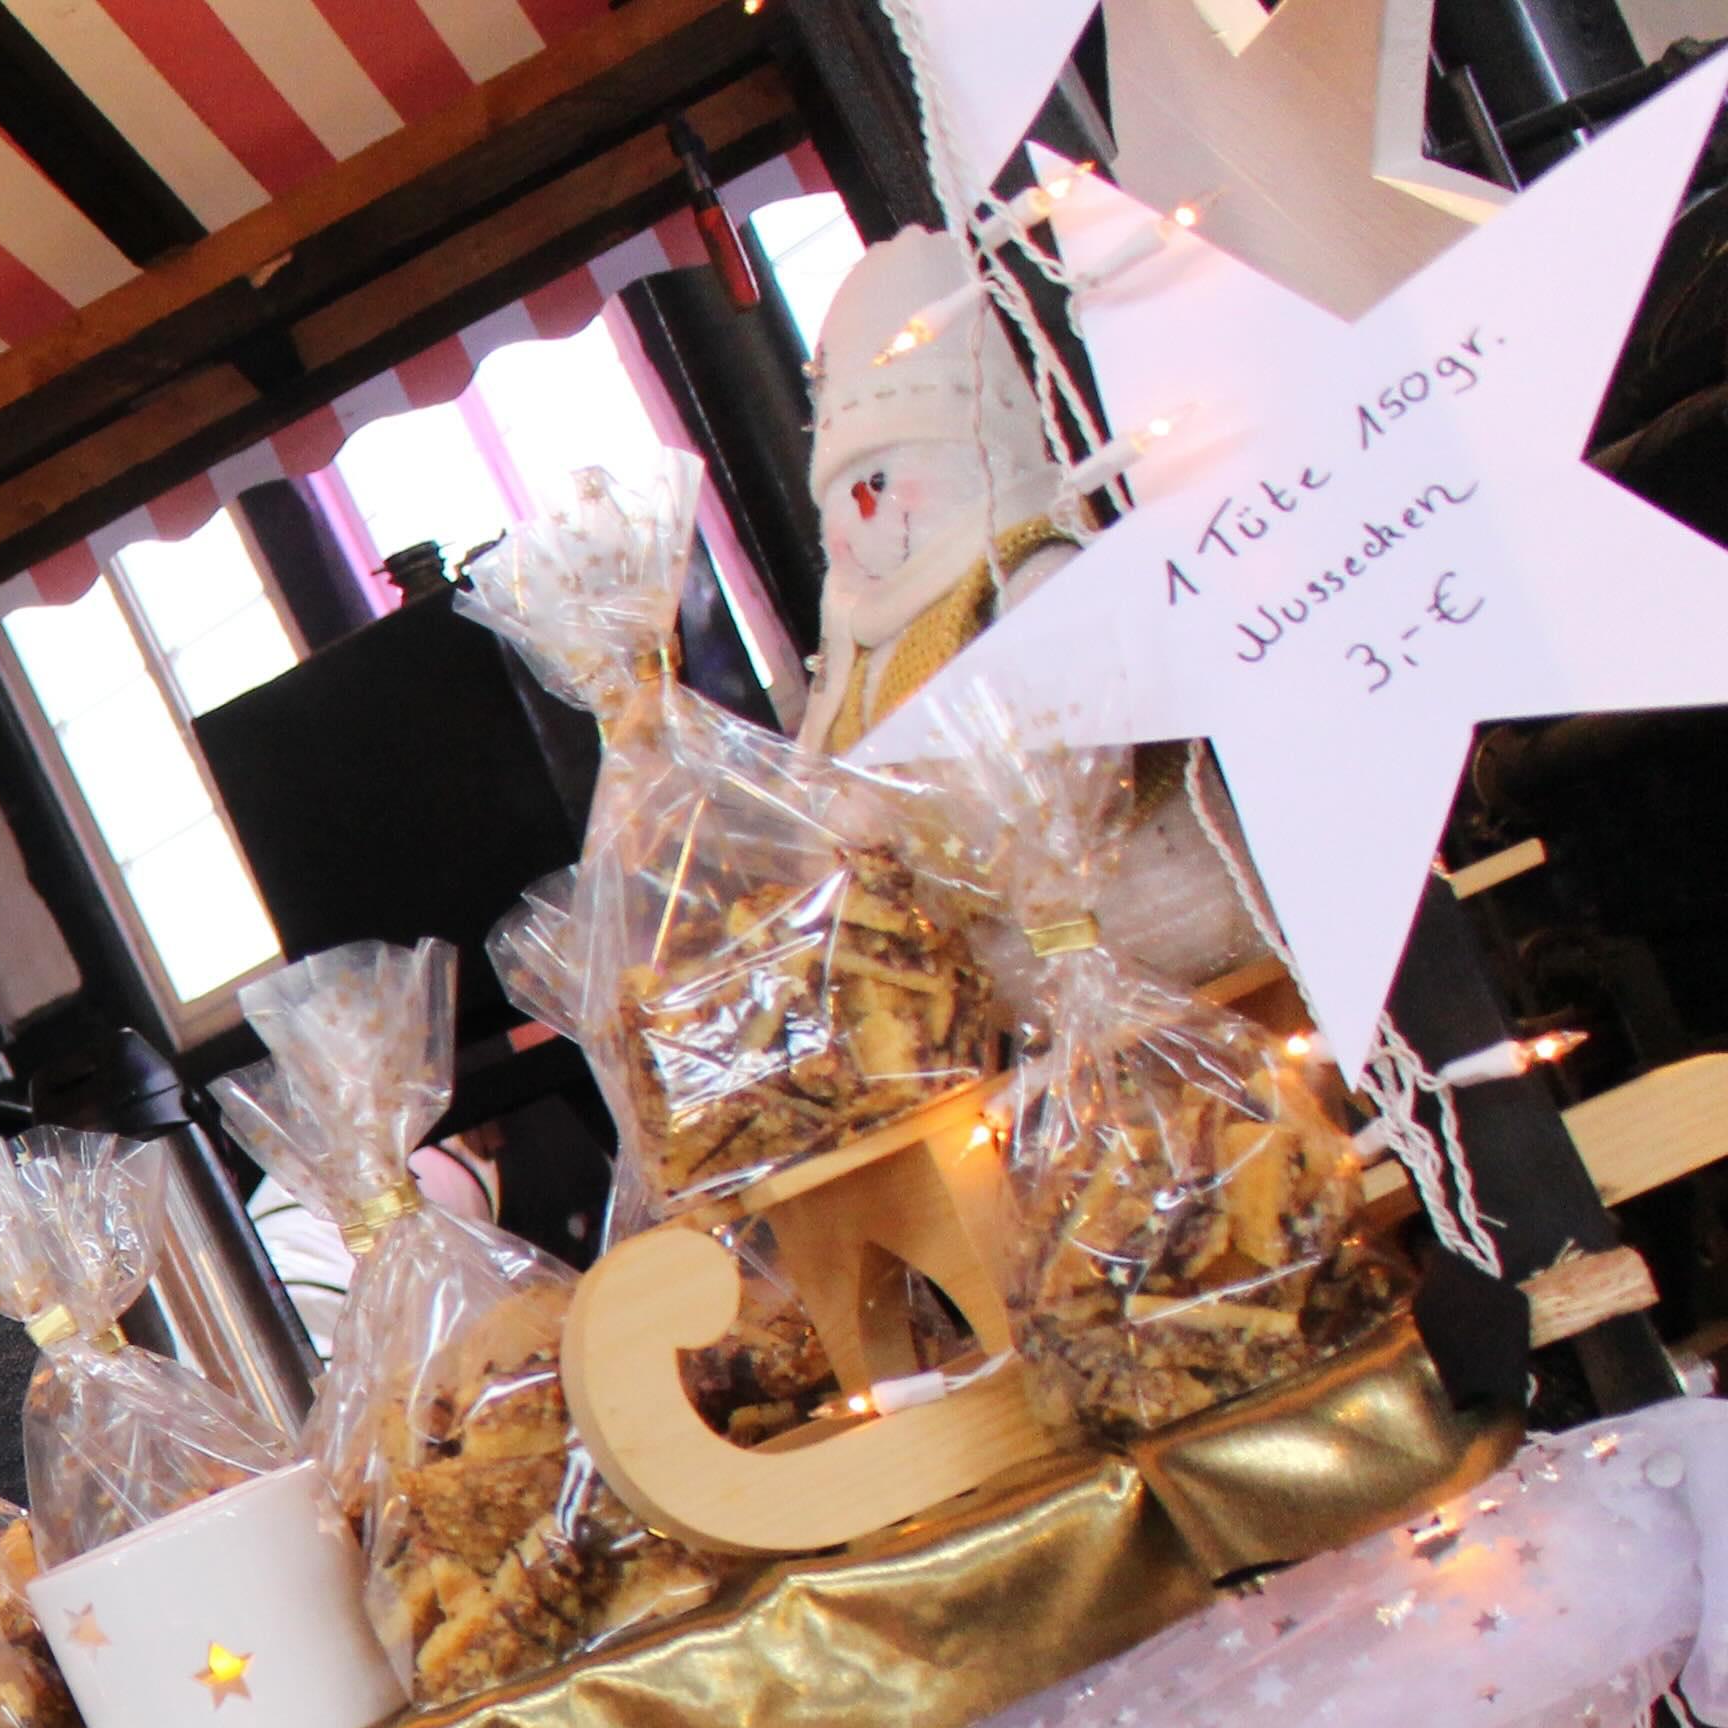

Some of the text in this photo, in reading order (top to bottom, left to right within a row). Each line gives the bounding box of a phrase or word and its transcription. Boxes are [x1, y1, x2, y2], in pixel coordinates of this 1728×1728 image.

[1165, 559, 1200, 606] 1
[1197, 468, 1332, 557] Tüte
[1236, 480, 1480, 663] Nussecken
